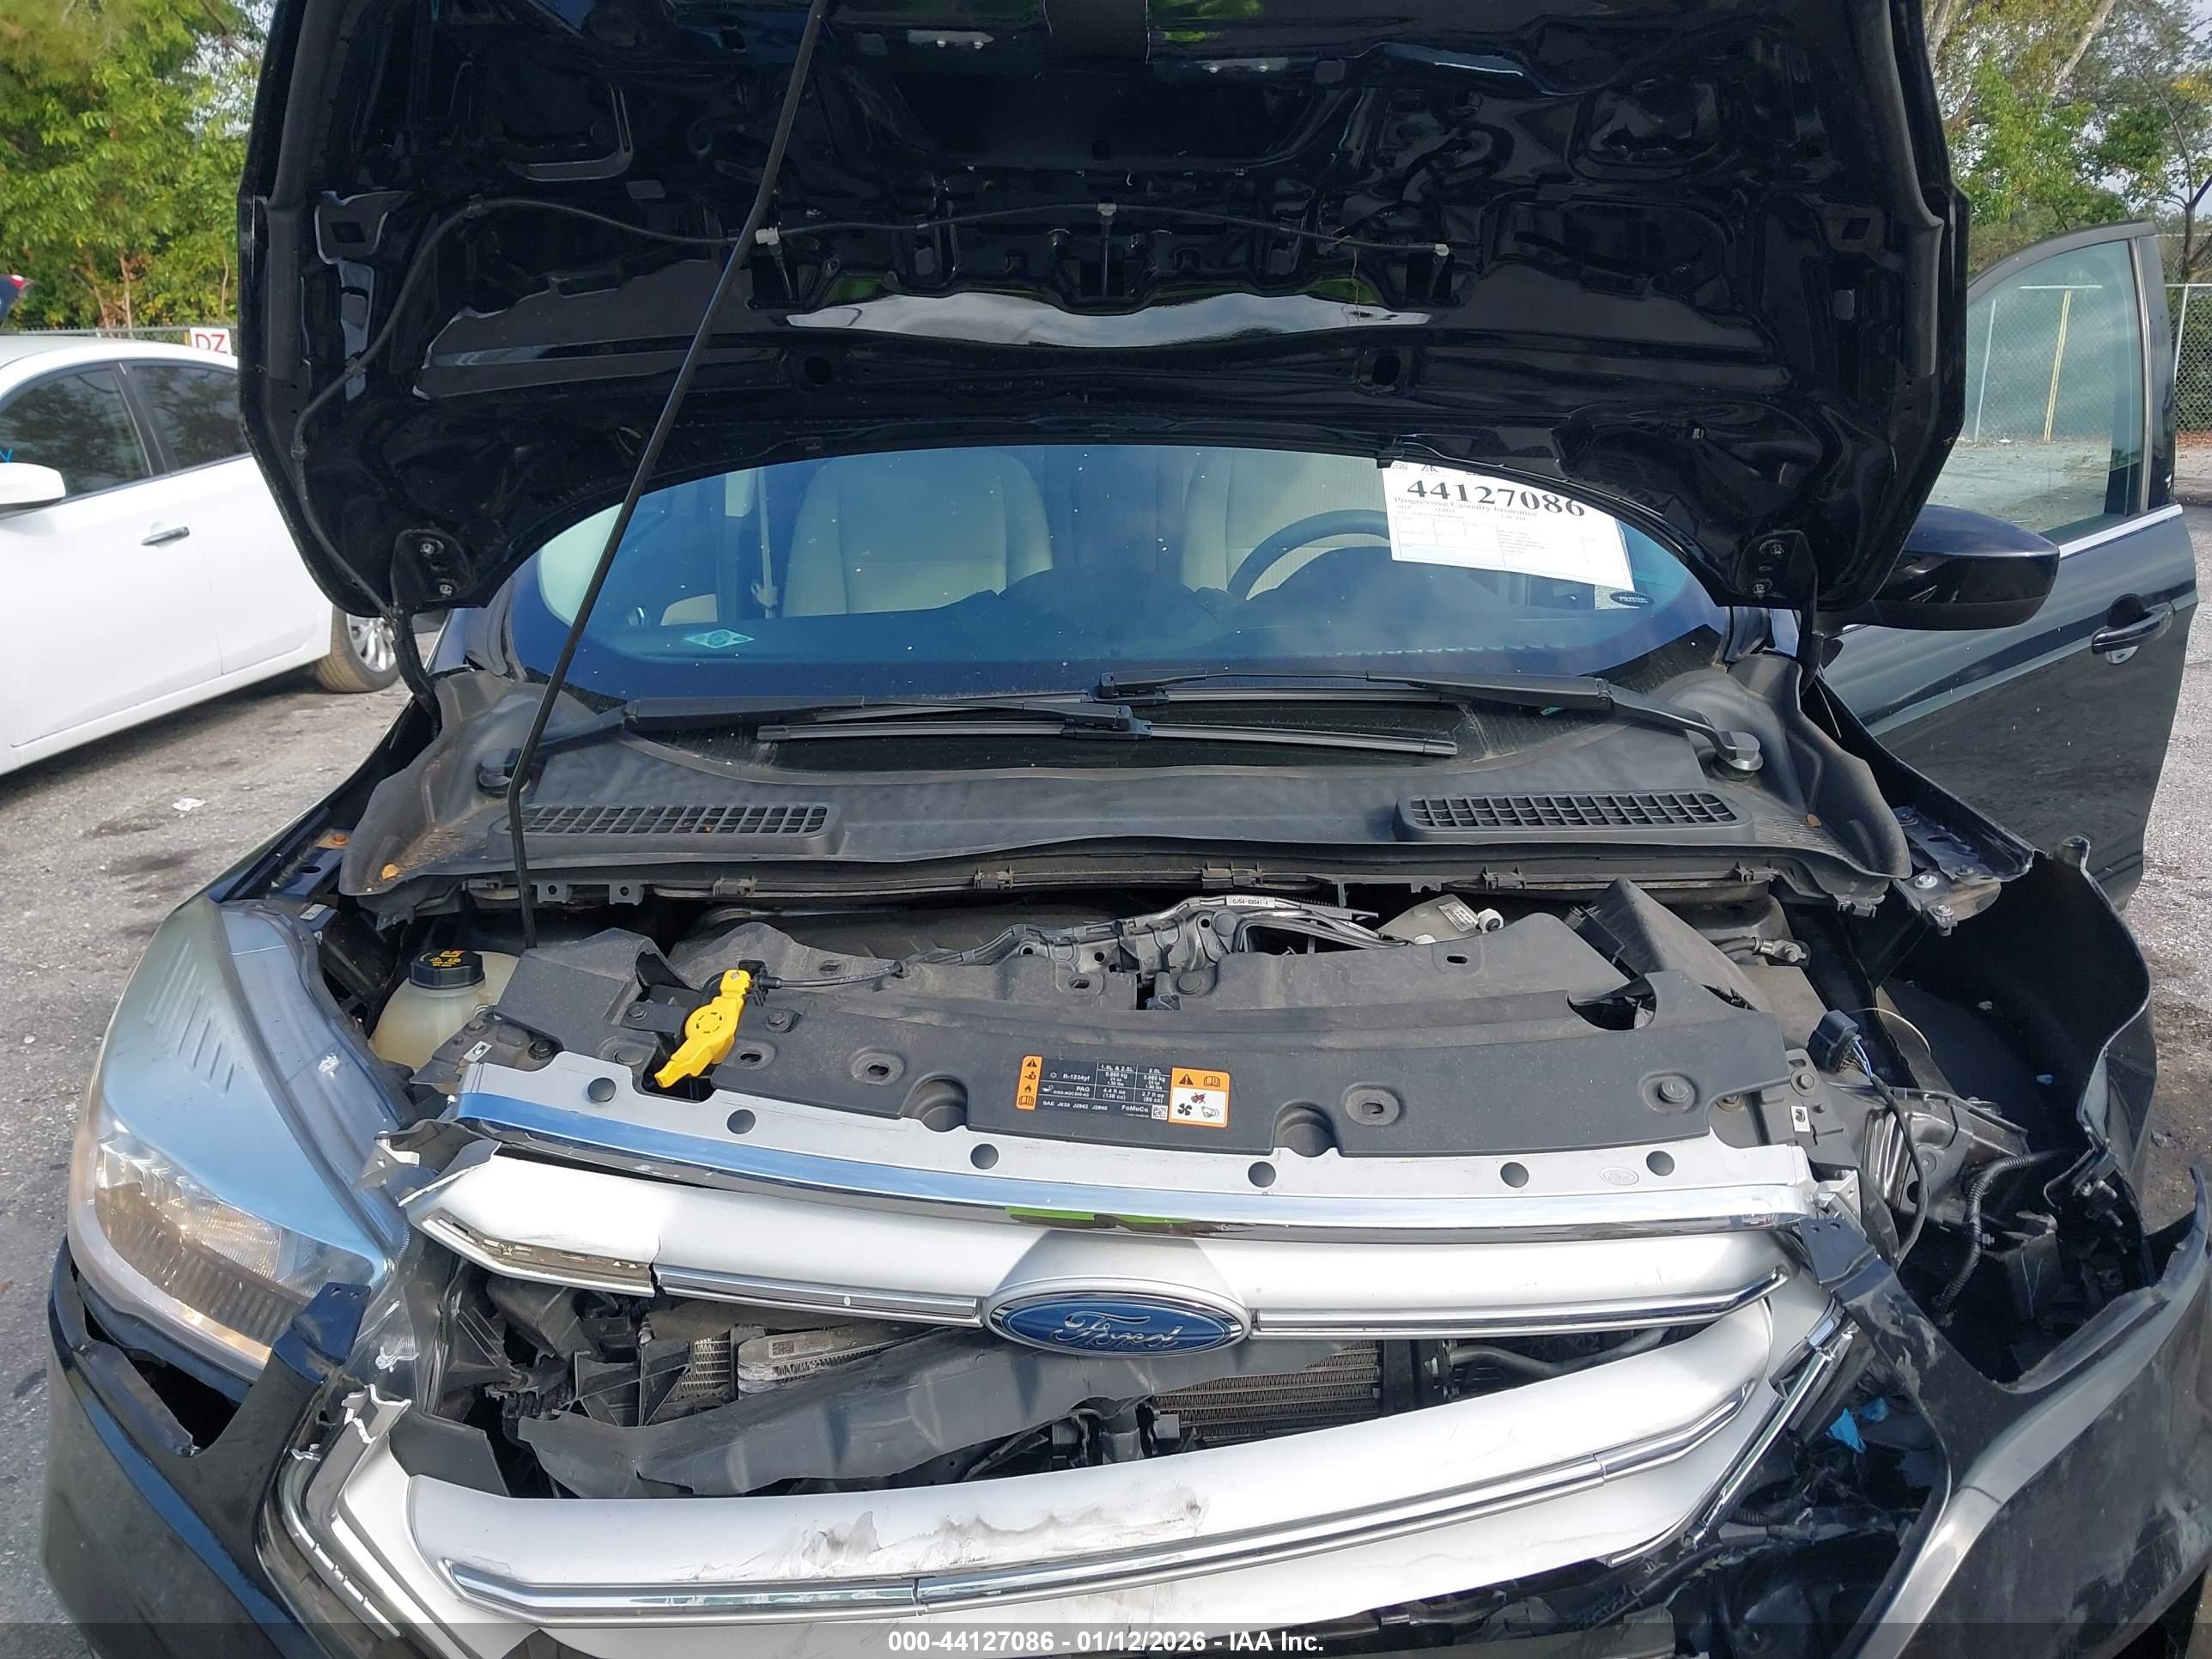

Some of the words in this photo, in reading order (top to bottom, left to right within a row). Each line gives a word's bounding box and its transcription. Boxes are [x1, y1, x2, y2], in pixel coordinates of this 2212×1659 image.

[1395, 495, 1449, 507] Progressive
[1451, 501, 1491, 513] Casualty
[1494, 506, 1538, 517] Insurance
[1407, 480, 1585, 517] 44127086
[1121, 1104, 1149, 1113] FoMoCo
[1050, 1311, 1184, 1348] Ford
